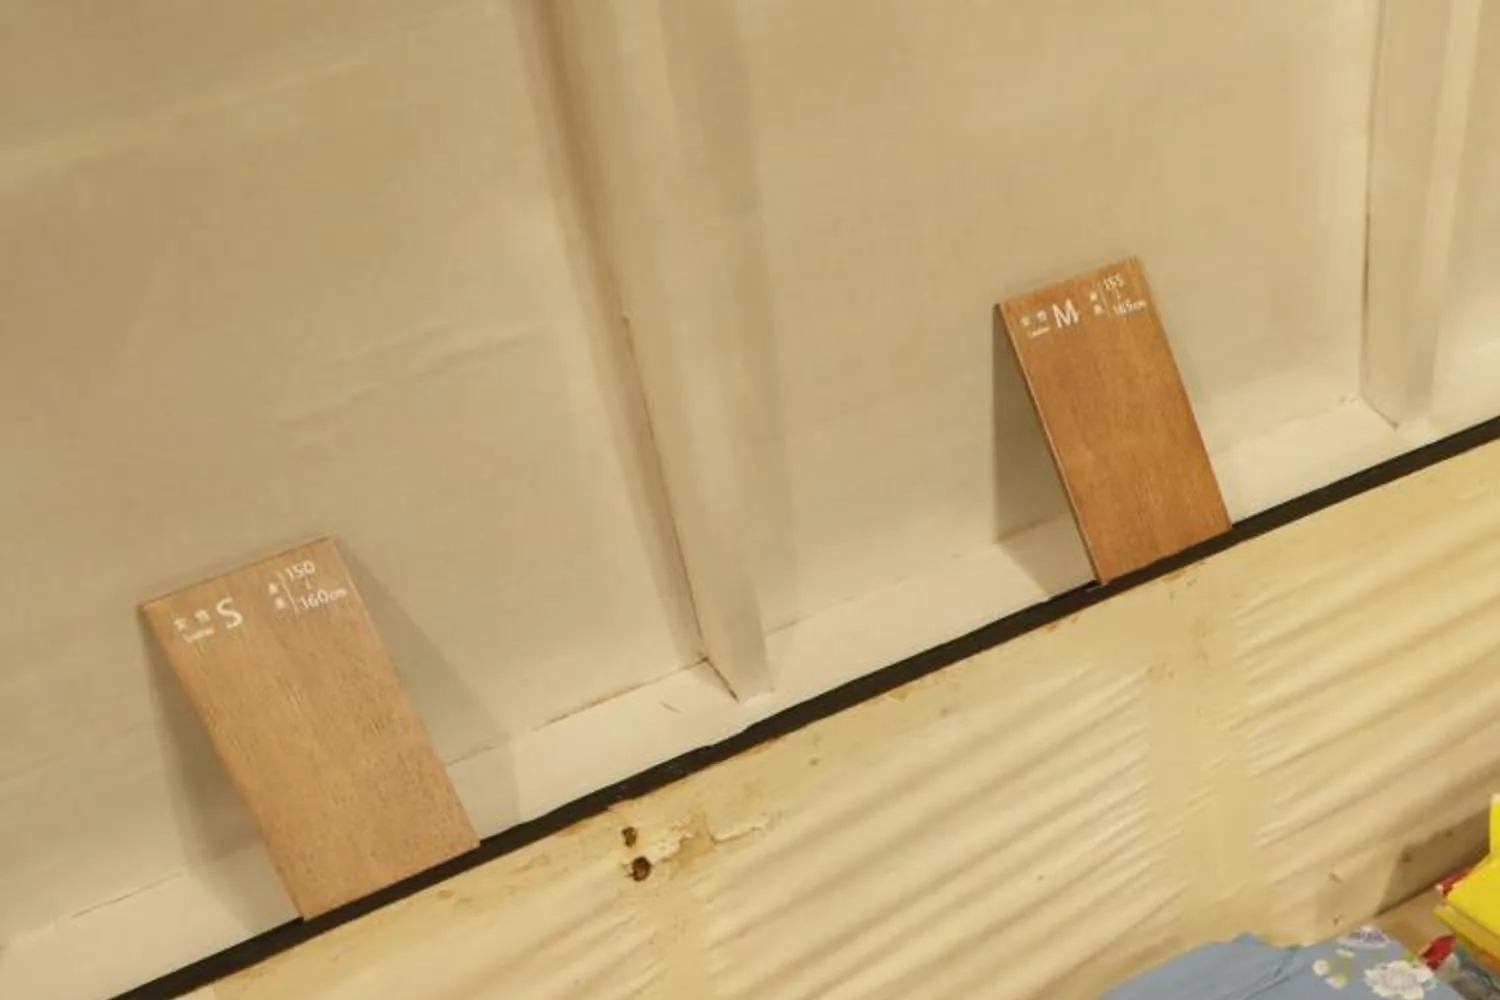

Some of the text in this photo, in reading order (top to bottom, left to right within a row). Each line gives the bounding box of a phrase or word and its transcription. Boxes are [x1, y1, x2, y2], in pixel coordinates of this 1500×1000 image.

[1052, 298, 1079, 329] M
[285, 560, 316, 583] 150
[299, 588, 349, 610] 160cm
[216, 597, 244, 630] S
